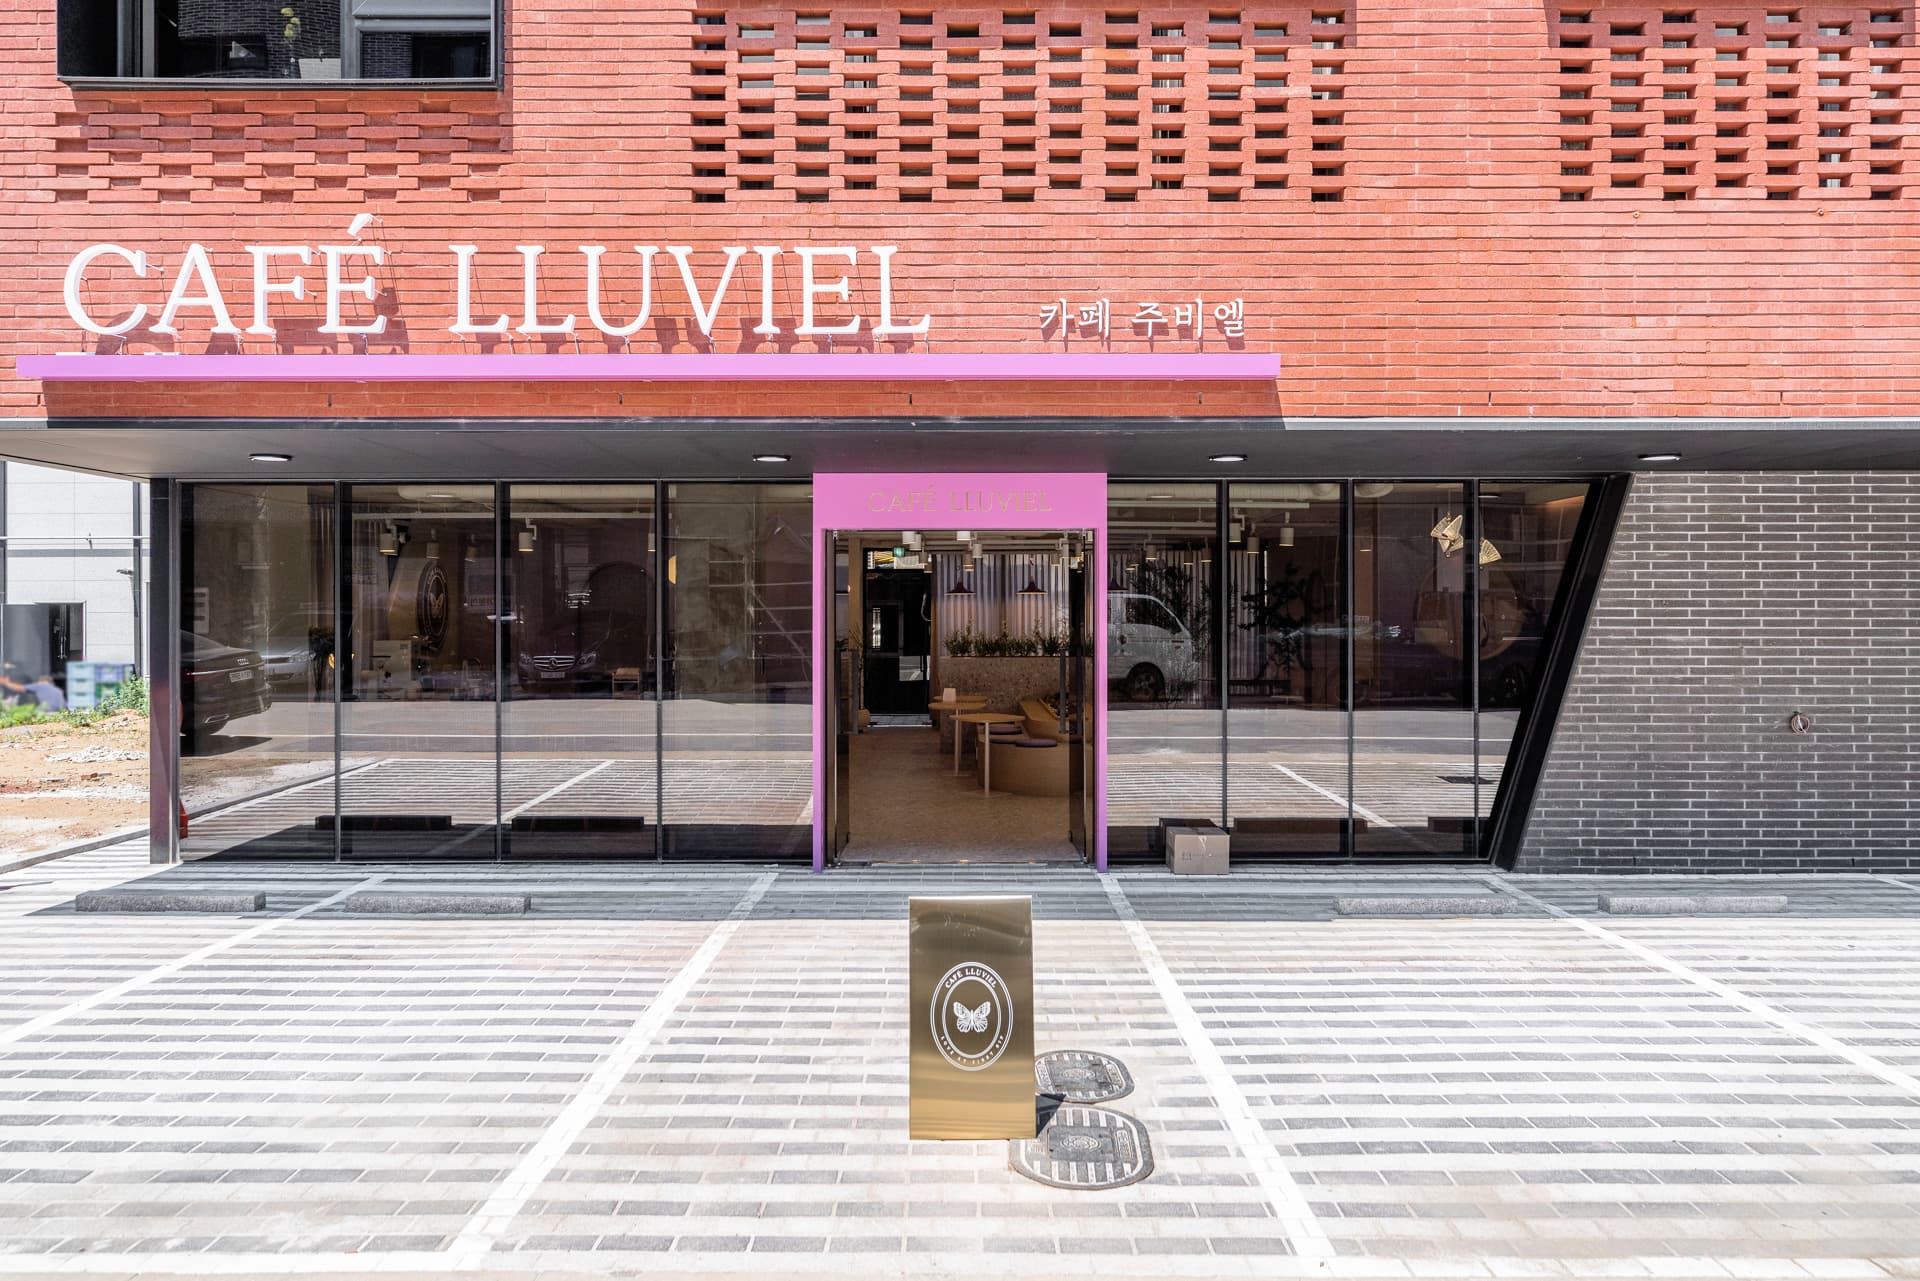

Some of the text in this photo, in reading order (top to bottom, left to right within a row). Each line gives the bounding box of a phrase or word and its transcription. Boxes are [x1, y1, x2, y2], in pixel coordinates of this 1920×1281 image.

[63, 213, 930, 337] CAFÉ LLUVIEL
[1040, 298, 1245, 338] 카페 주비엘
[867, 484, 1053, 513] CAFÉ LLUVIEL
[965, 967, 997, 988] LLUVIEL
